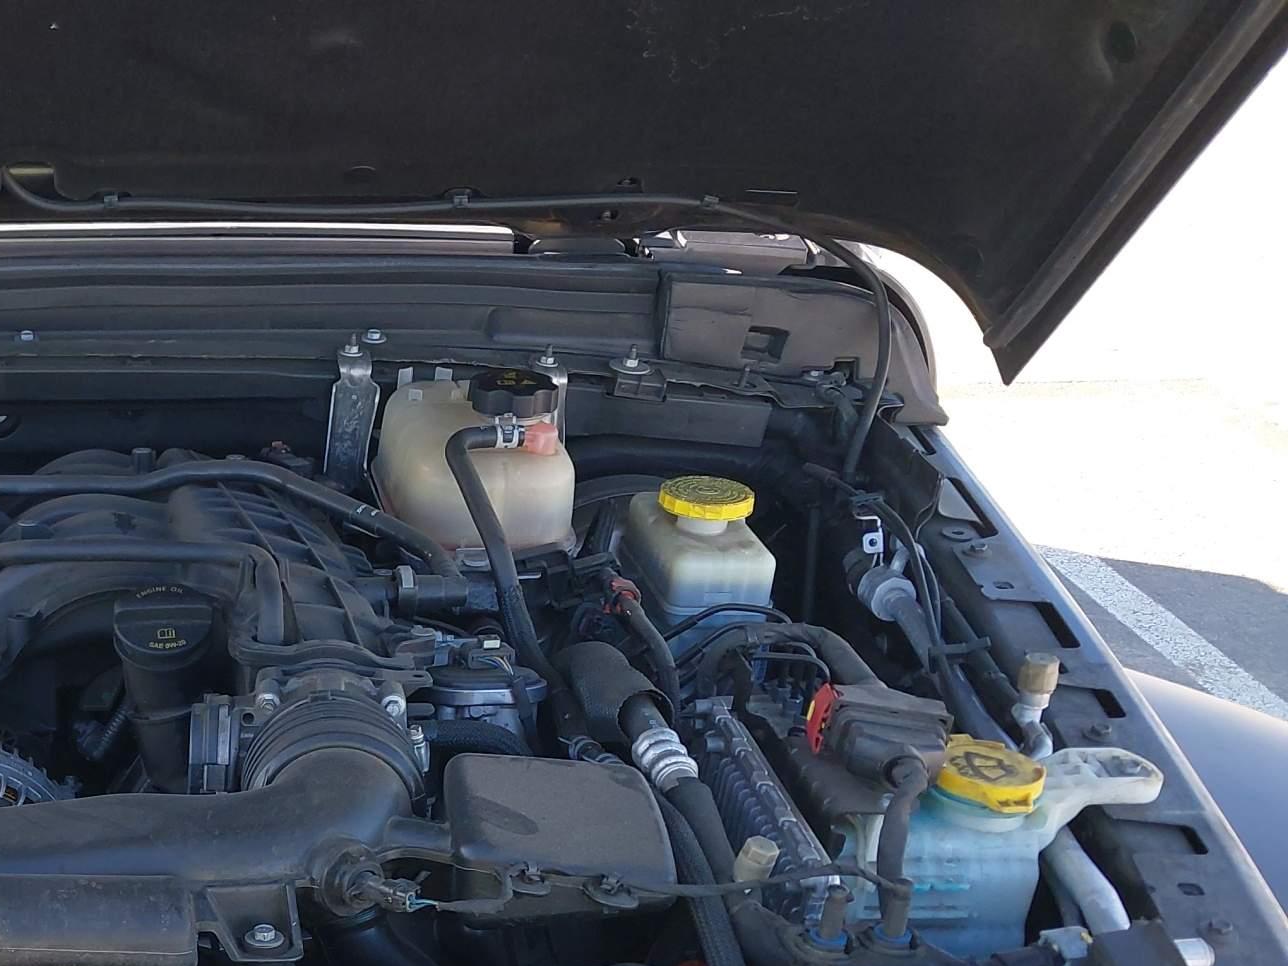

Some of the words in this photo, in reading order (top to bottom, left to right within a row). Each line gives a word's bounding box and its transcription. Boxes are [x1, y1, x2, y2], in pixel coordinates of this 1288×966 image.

[136, 586, 166, 599] ENGINE
[170, 586, 184, 594] OIL
[149, 641, 164, 649] SAE
